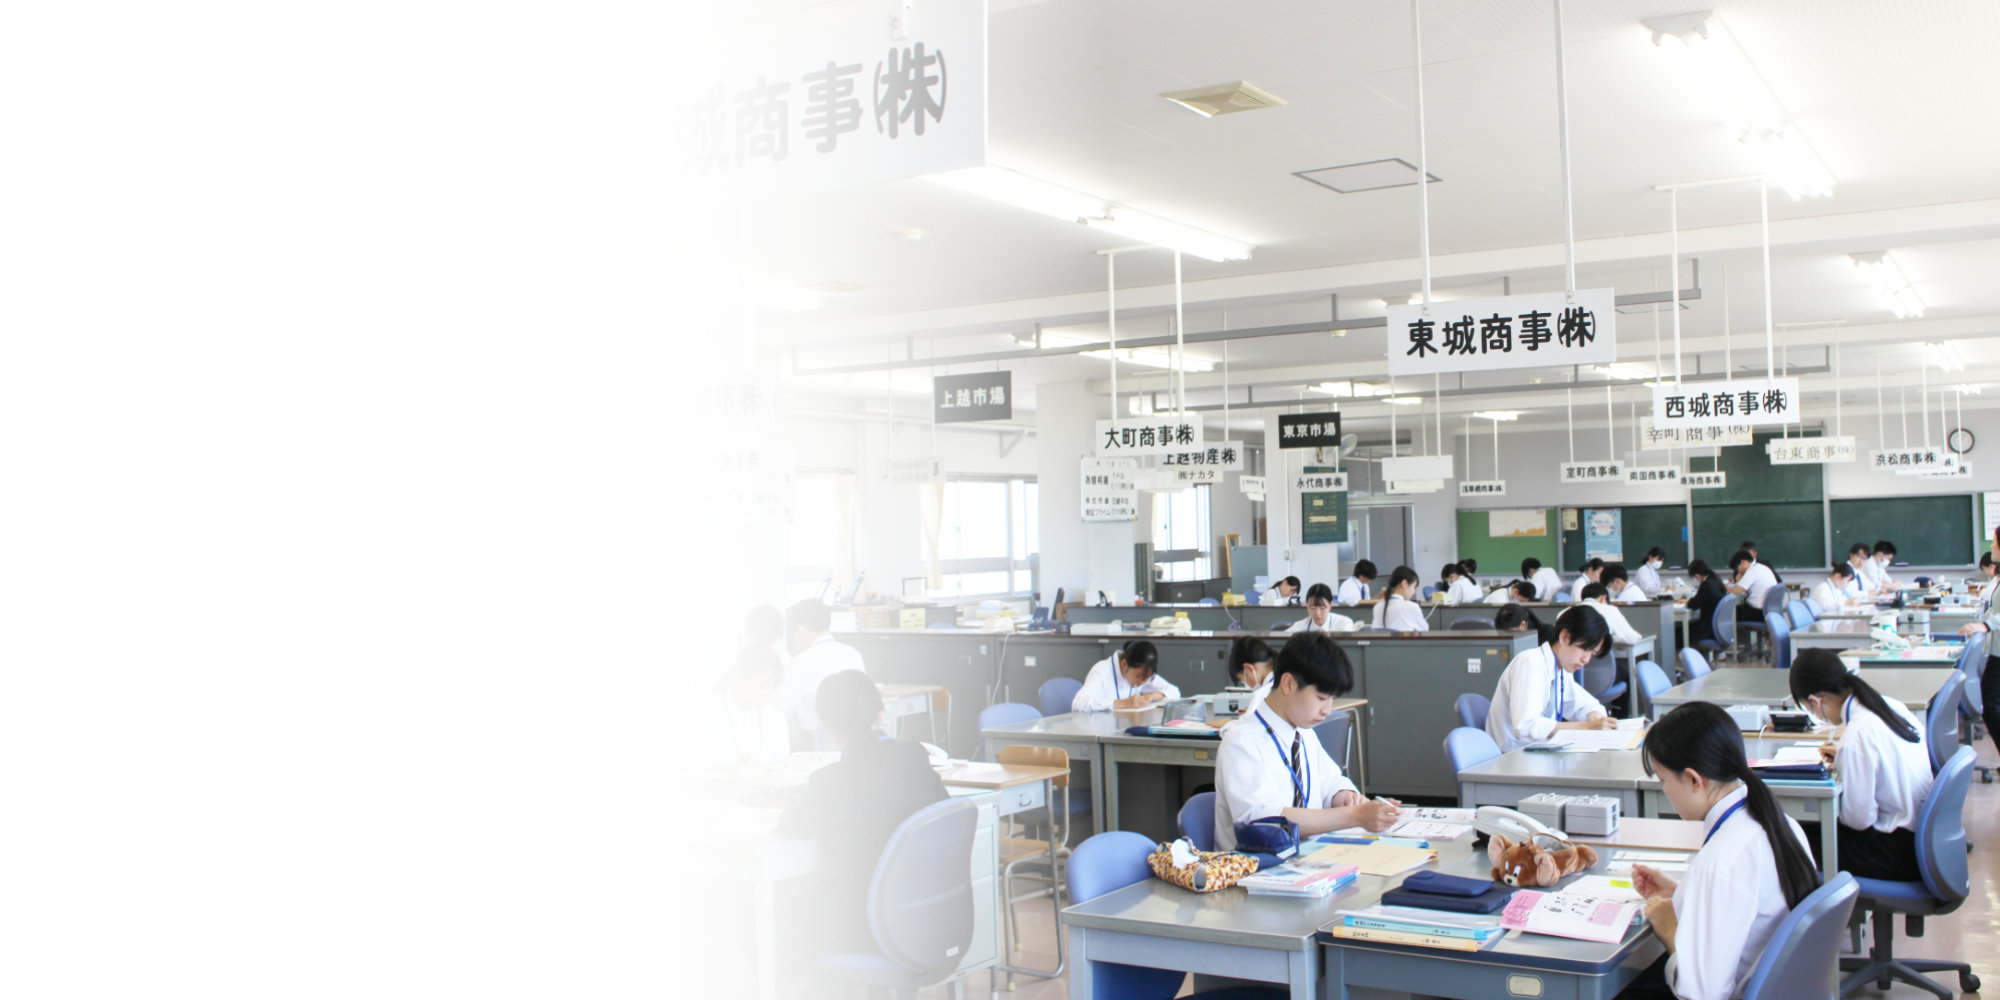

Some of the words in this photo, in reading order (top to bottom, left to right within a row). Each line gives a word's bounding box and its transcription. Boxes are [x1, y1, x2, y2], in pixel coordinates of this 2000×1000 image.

[648, 42, 947, 175] 城商事(株)
[1406, 305, 1596, 358] 東城商事(株)
[940, 386, 1006, 409] 上越市場
[1664, 388, 1788, 418] 西城商事(株)
[1104, 423, 1195, 450] 大町商事(株)
[1282, 421, 1336, 438] 東京市場
